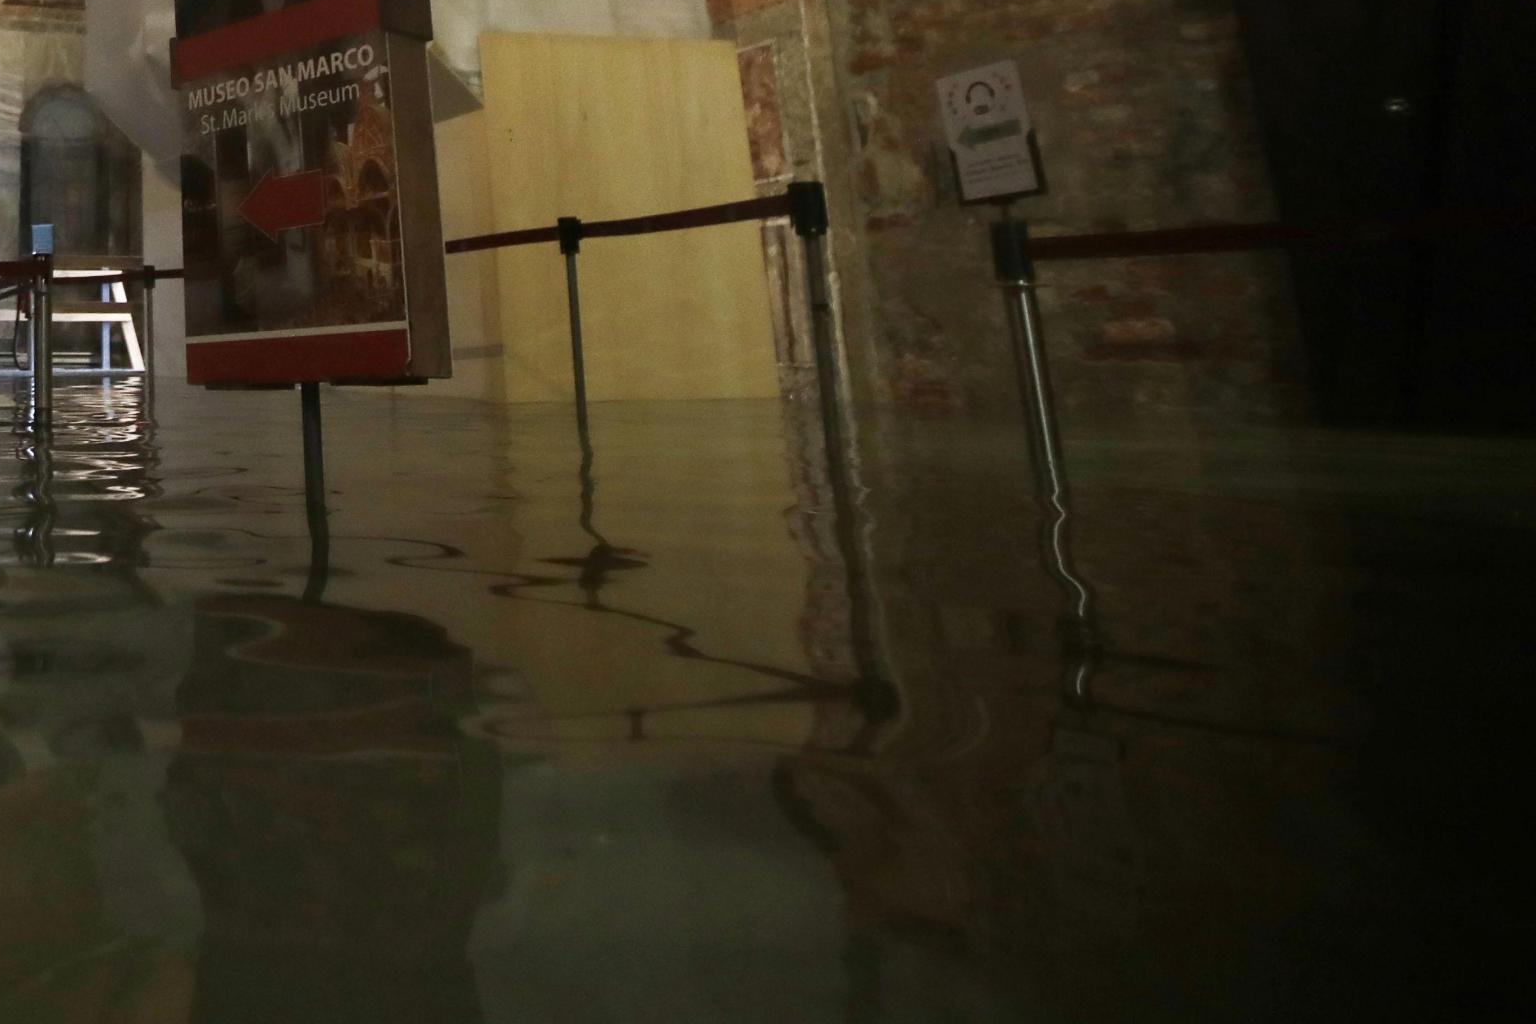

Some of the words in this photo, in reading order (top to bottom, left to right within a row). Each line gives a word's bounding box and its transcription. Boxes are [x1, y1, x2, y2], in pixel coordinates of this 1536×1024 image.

[188, 77, 250, 110] MUSEO
[254, 64, 293, 93] SAN
[298, 44, 374, 82] MARCO
[200, 114, 220, 135] St.
[279, 83, 360, 116] Museum
